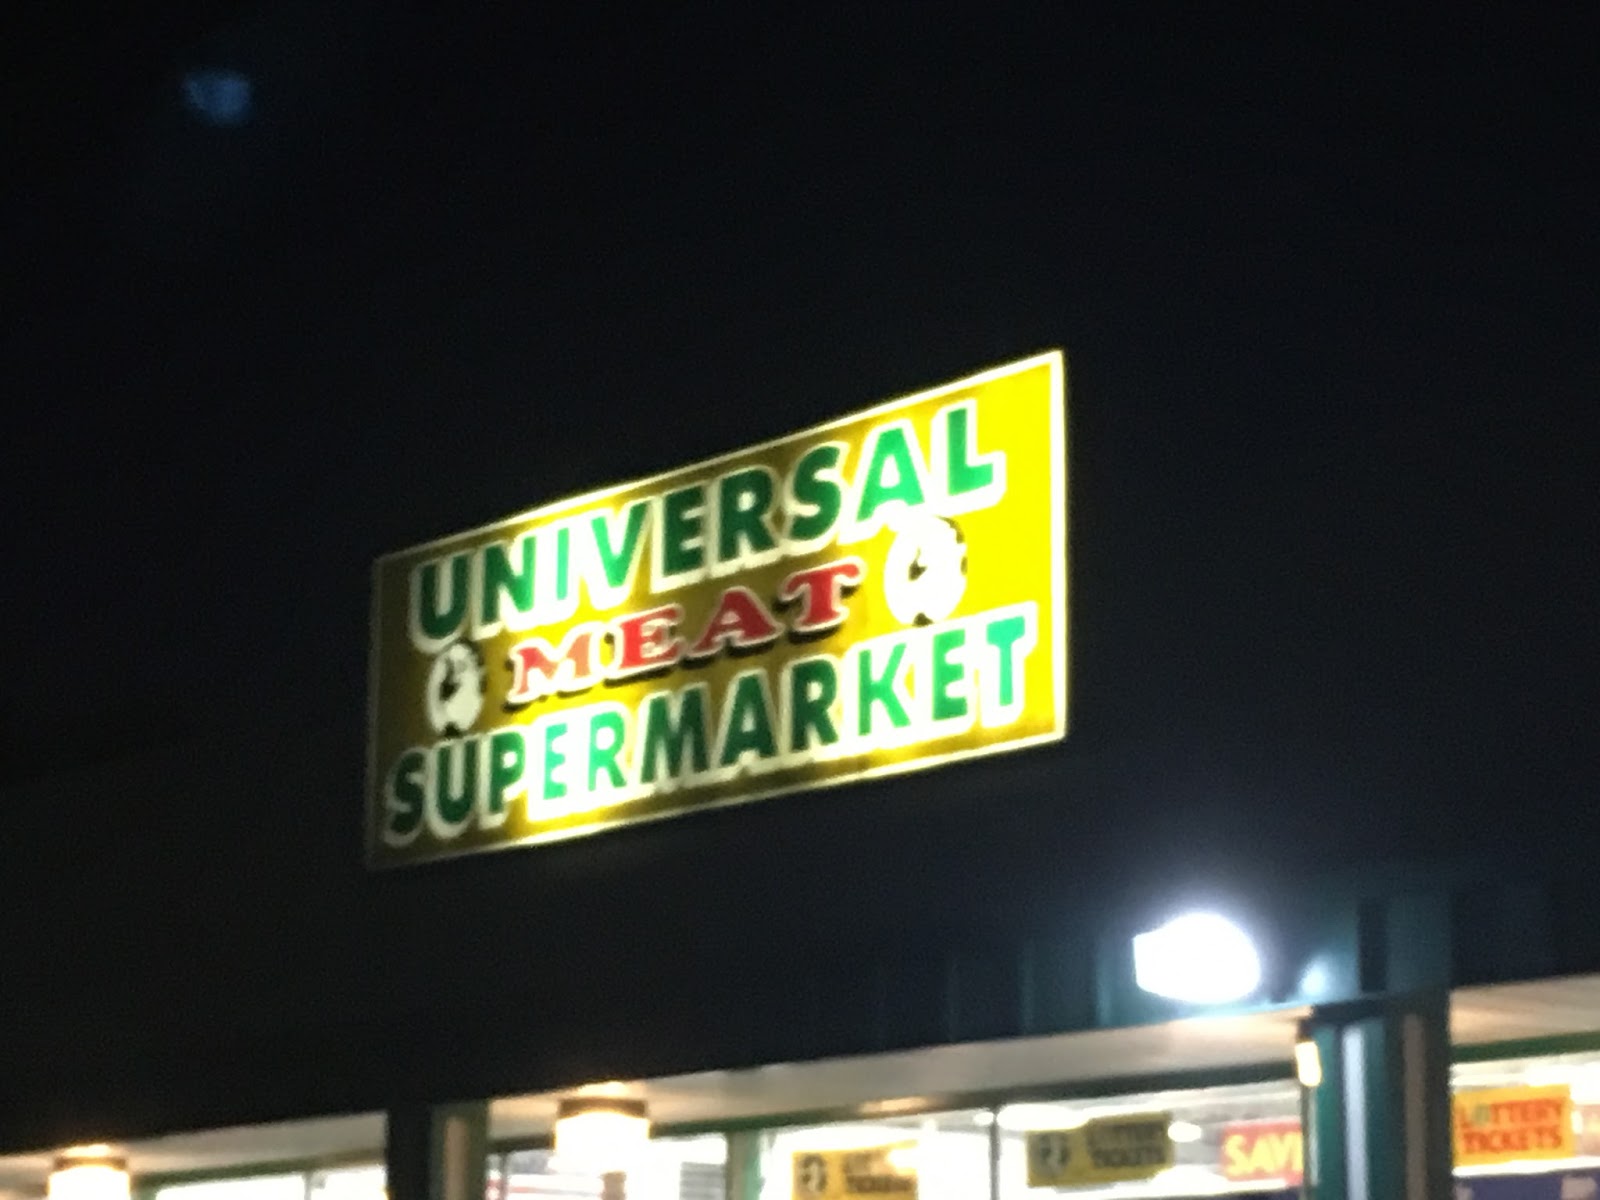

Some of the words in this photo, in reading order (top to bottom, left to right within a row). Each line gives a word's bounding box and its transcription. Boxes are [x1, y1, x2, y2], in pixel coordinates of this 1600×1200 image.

[415, 404, 1000, 644] UNIVERSAL
[506, 560, 864, 706] MEAT
[385, 612, 1031, 842] SUPERMARKET
